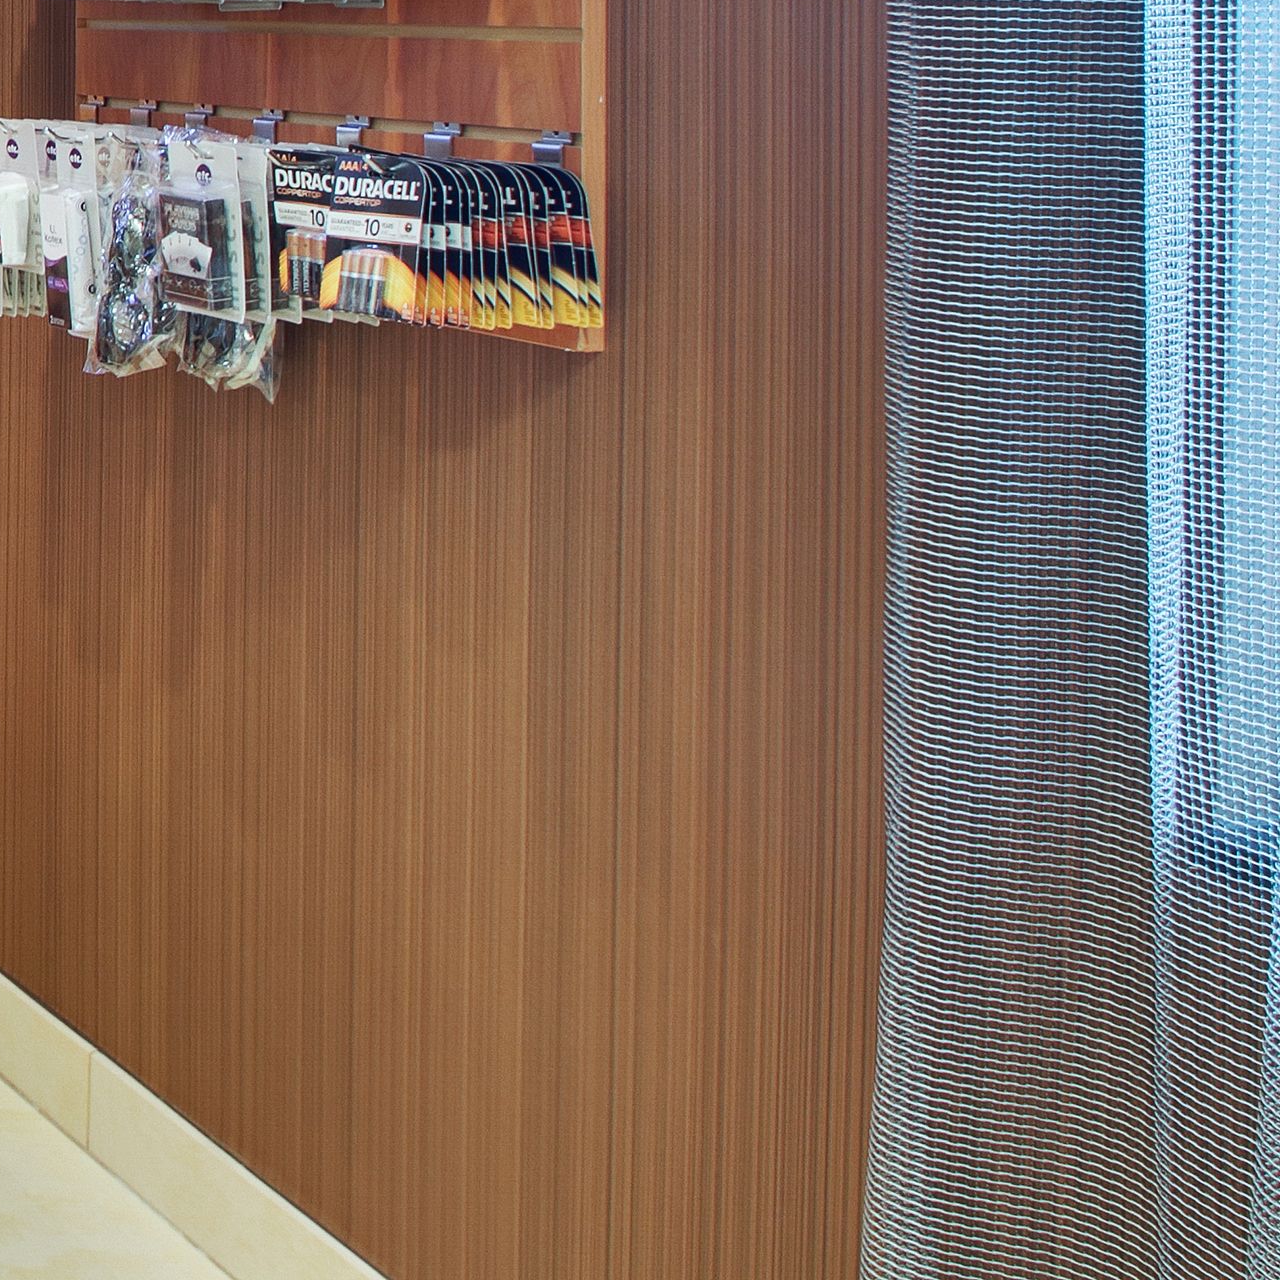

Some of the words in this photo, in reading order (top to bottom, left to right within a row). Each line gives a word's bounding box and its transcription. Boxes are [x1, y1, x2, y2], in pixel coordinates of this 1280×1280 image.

[339, 161, 359, 171] AAA
[276, 188, 322, 198] COPPERTOP
[334, 177, 419, 201] DURACELL
[334, 196, 381, 206] COPPERTOP
[310, 210, 325, 227] 10
[365, 219, 380, 237] 10
